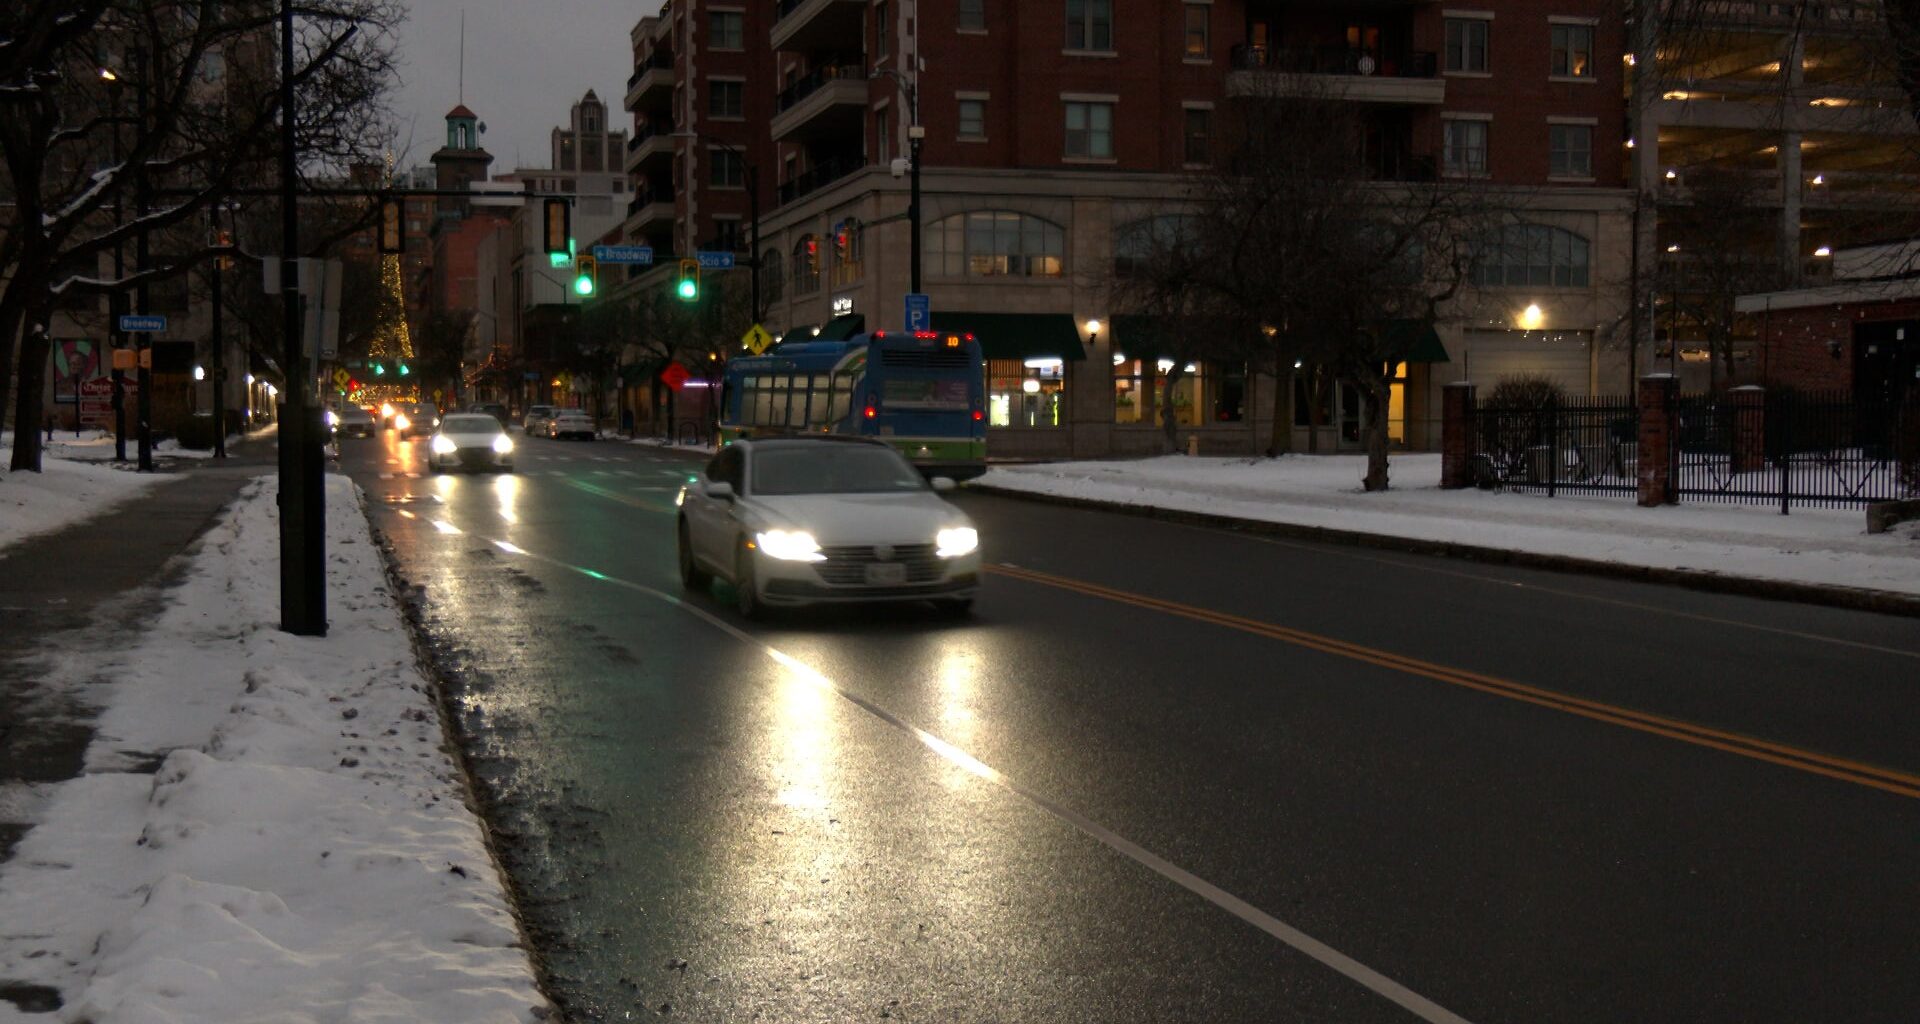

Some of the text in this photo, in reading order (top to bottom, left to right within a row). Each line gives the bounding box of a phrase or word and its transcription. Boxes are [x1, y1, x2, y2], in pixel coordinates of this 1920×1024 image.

[606, 247, 651, 263] Broadway
[699, 255, 719, 267] Scio
[122, 318, 162, 330] Broadway
[911, 311, 923, 327] P
[947, 336, 960, 347] 10
